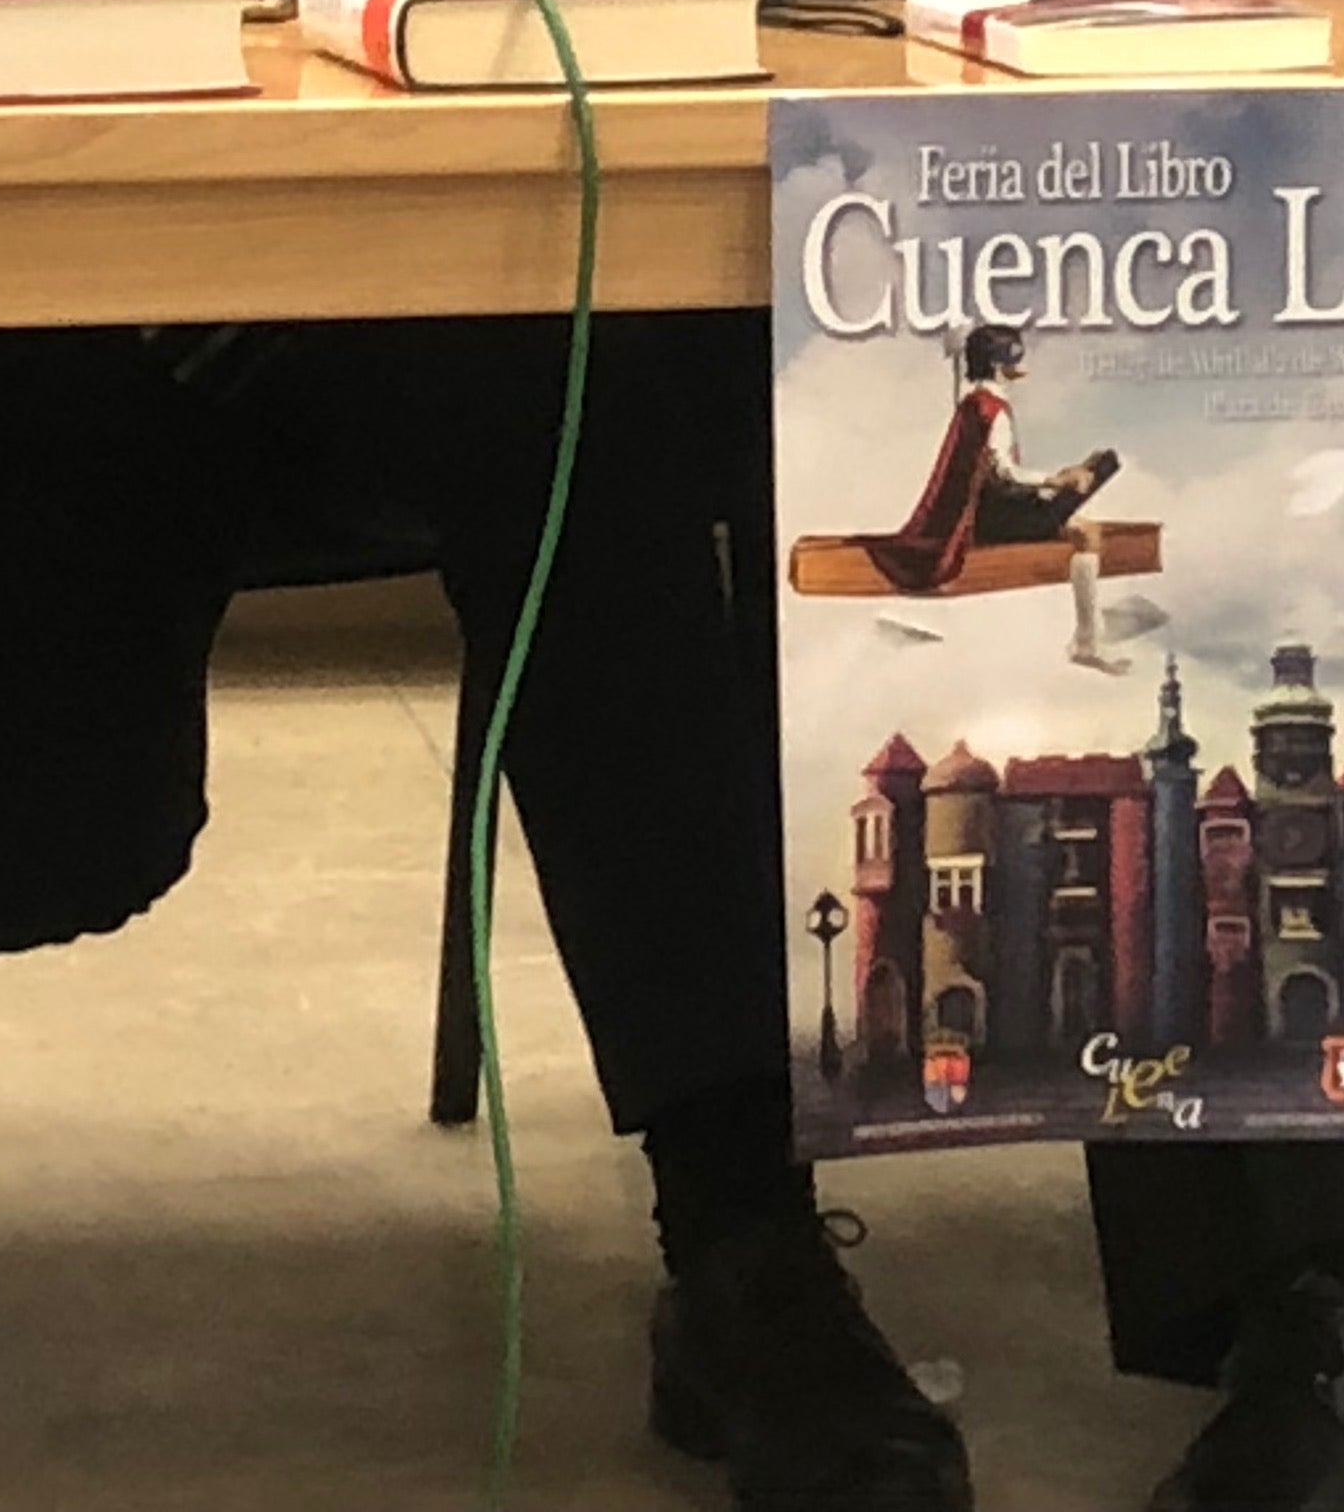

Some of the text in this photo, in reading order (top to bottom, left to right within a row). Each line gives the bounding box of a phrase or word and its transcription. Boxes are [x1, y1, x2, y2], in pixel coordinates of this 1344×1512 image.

[918, 141, 1233, 203] Feria del Libro
[801, 190, 1239, 335] Cuenca
